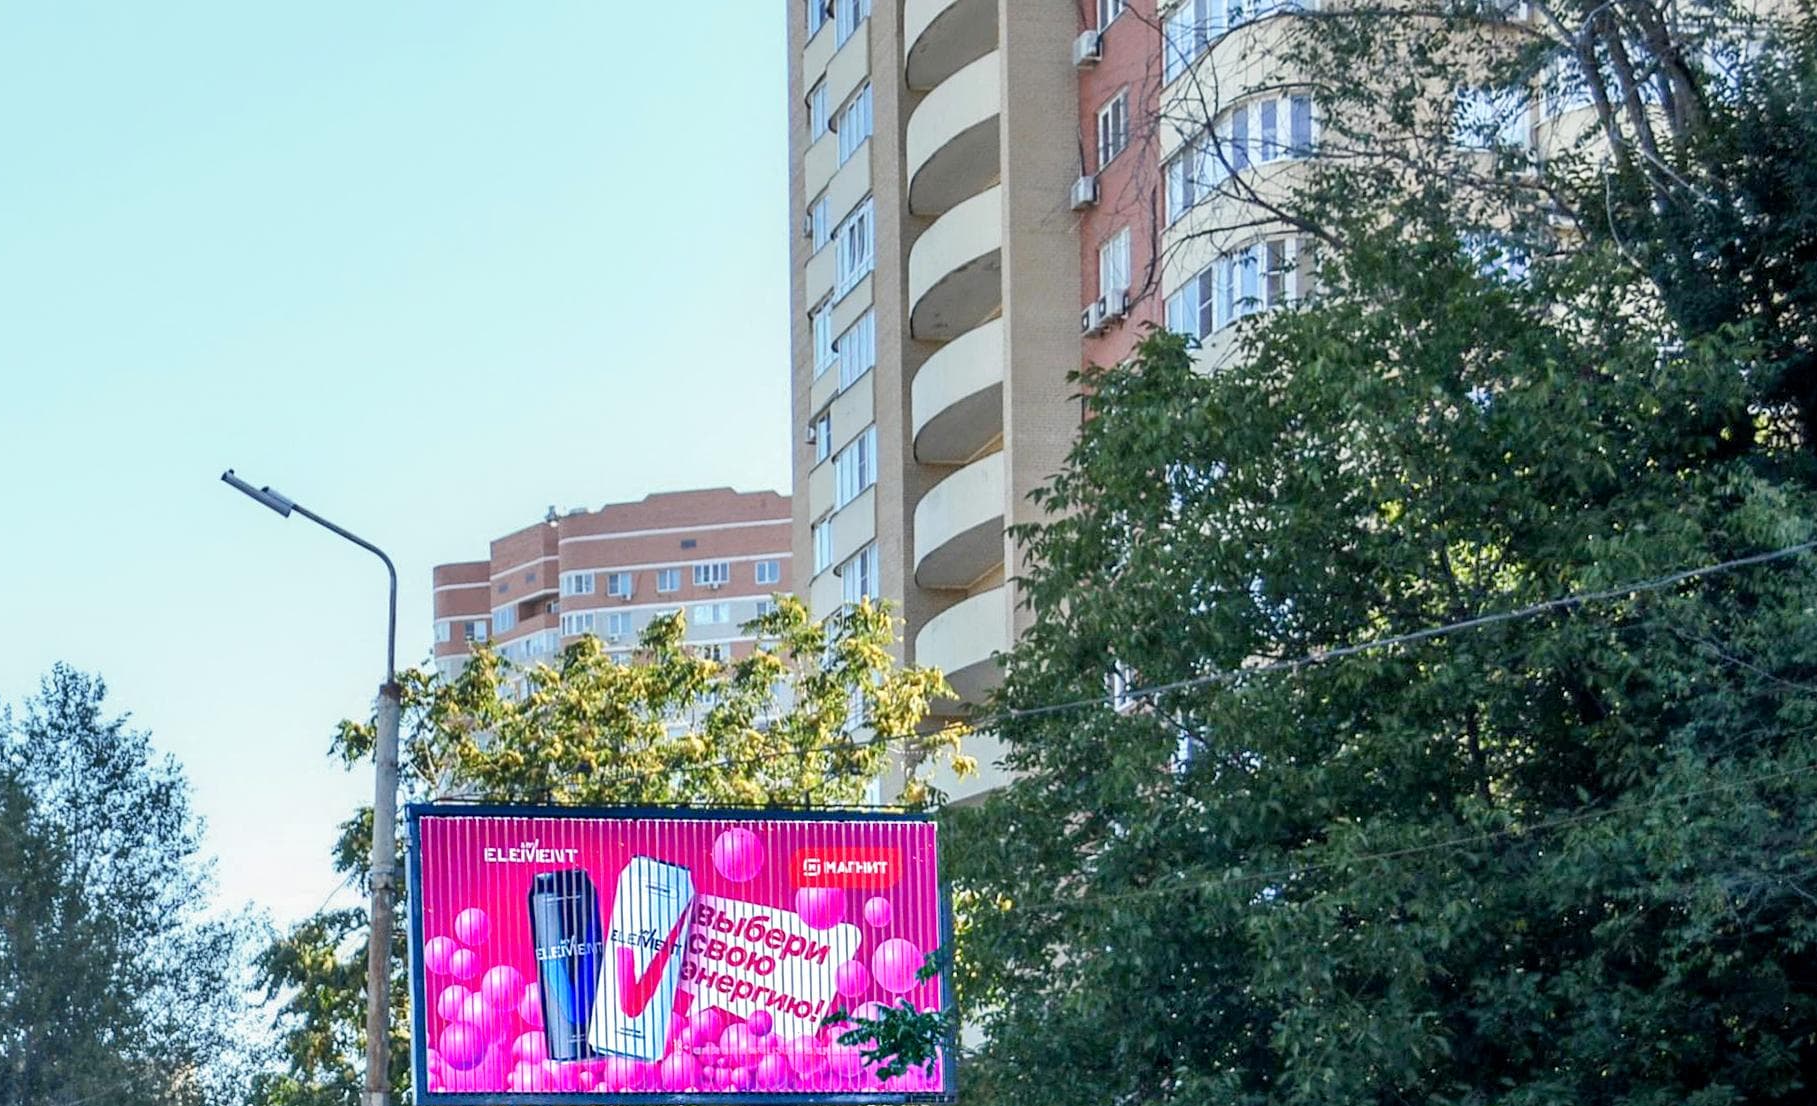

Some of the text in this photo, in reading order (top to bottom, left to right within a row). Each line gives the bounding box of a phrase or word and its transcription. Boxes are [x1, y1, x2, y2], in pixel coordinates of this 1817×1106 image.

[484, 848, 578, 863] ELEMENT
[824, 860, 888, 875] МАГНИТ
[689, 932, 776, 976] свою
[680, 961, 825, 1022] энергию!
